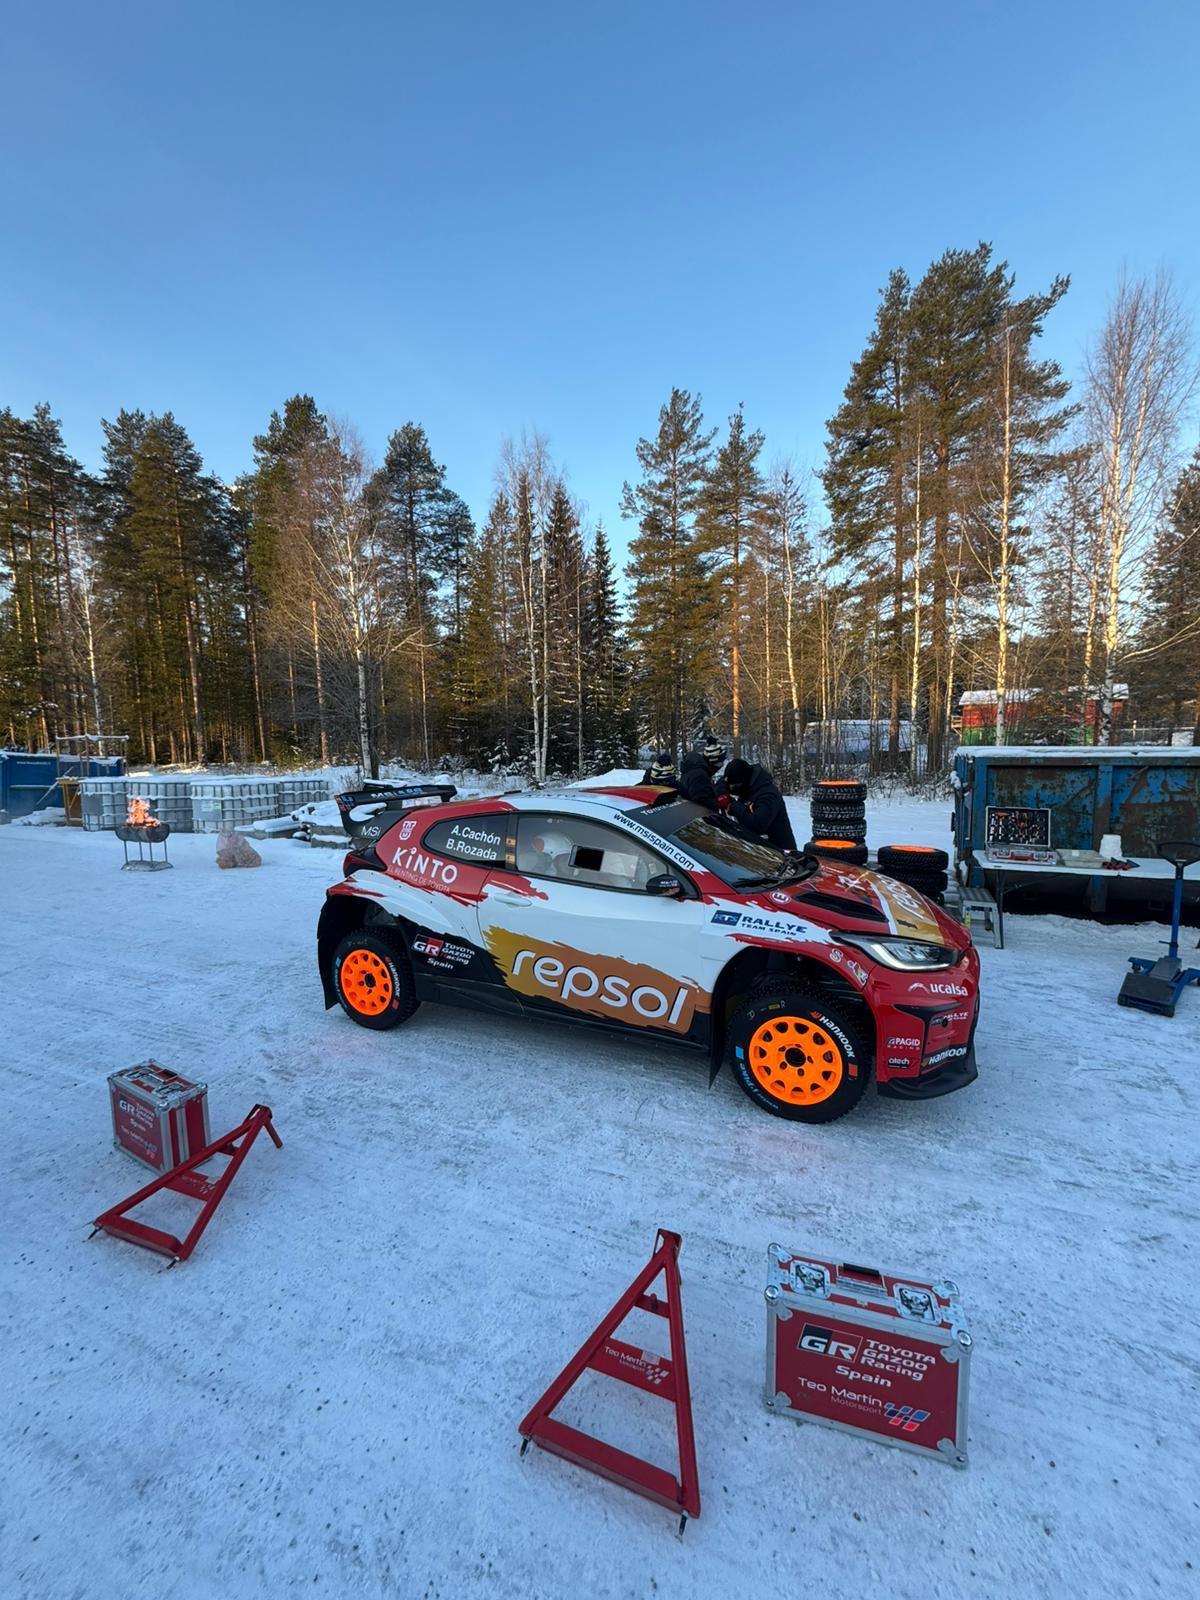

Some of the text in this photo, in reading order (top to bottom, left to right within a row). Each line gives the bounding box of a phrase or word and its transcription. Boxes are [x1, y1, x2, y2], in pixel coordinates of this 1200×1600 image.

[451, 824, 501, 846] A.Cachón
[613, 813, 695, 870] www.msispain.com
[446, 838, 497, 860] B.Rozada
[741, 923, 765, 931] TEAM
[742, 915, 807, 933] RALLYE
[413, 941, 440, 956] GR
[442, 947, 472, 959] GAZOO
[445, 942, 475, 956] TOYOTA
[427, 957, 454, 969] Spain
[512, 950, 688, 1025] repsol
[930, 983, 968, 996] ucalsa
[895, 1038, 920, 1046] PAGID
[800, 1335, 856, 1360] GR
[866, 1338, 936, 1365] TOYOTA
[860, 1356, 924, 1381] Racing
[863, 1349, 928, 1371] GAZOO
[835, 1365, 892, 1387] Spain
[798, 1377, 883, 1407] Teo Martin
[831, 1395, 883, 1416] Motorsport
